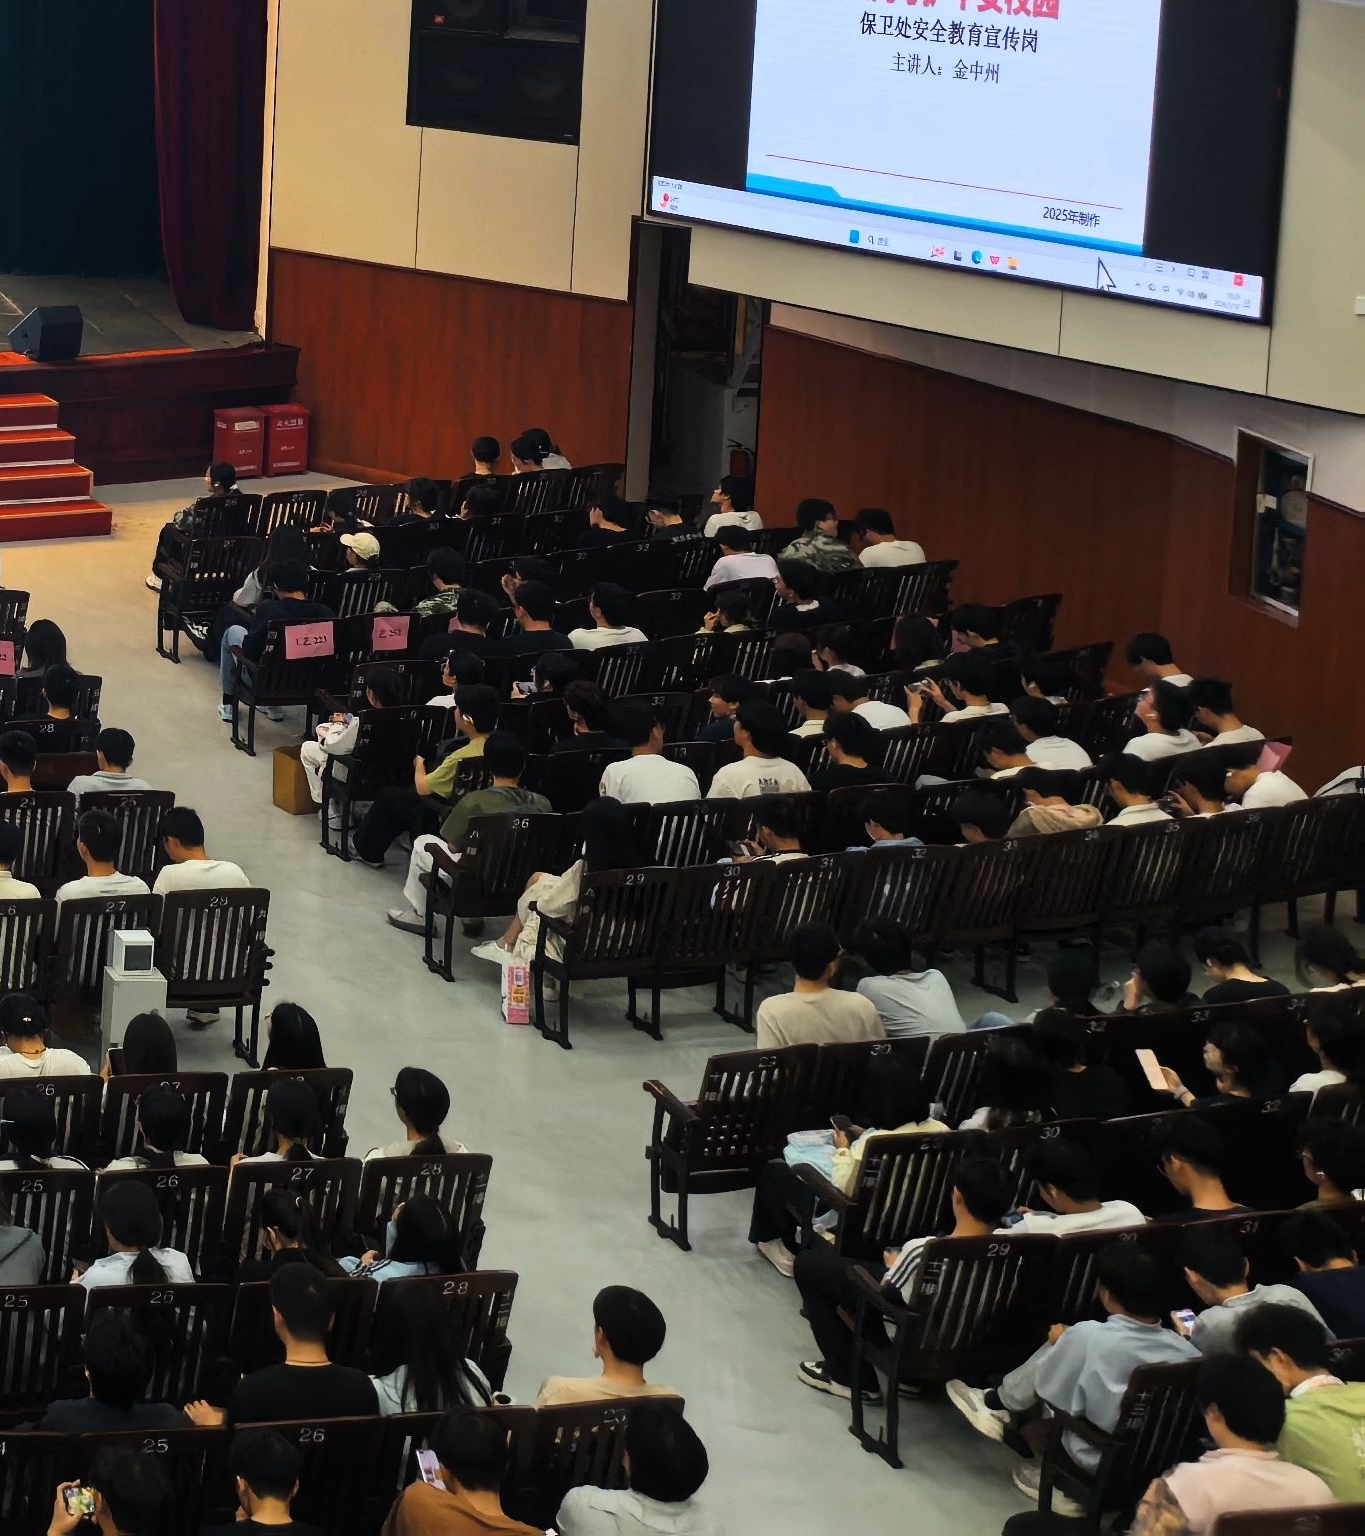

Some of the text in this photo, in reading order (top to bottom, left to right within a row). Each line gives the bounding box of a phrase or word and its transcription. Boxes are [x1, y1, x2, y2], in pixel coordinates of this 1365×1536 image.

[860, 10, 1039, 54] 保卫处安全教育宣传岗
[820, 856, 834, 869] 31
[723, 865, 741, 878] 30
[625, 873, 645, 886] 29
[36, 1083, 55, 1096] 26
[1039, 1125, 1062, 1140] 30
[291, 1167, 315, 1182] 27
[420, 1162, 443, 1176] 28
[20, 1179, 44, 1193] 25
[156, 1174, 179, 1188] 26
[986, 1243, 1011, 1257] 29
[442, 1279, 469, 1295] 28
[4, 1294, 28, 1308] 25
[149, 1290, 174, 1304] 26
[298, 1427, 326, 1443] 26
[142, 1438, 169, 1454] 25
